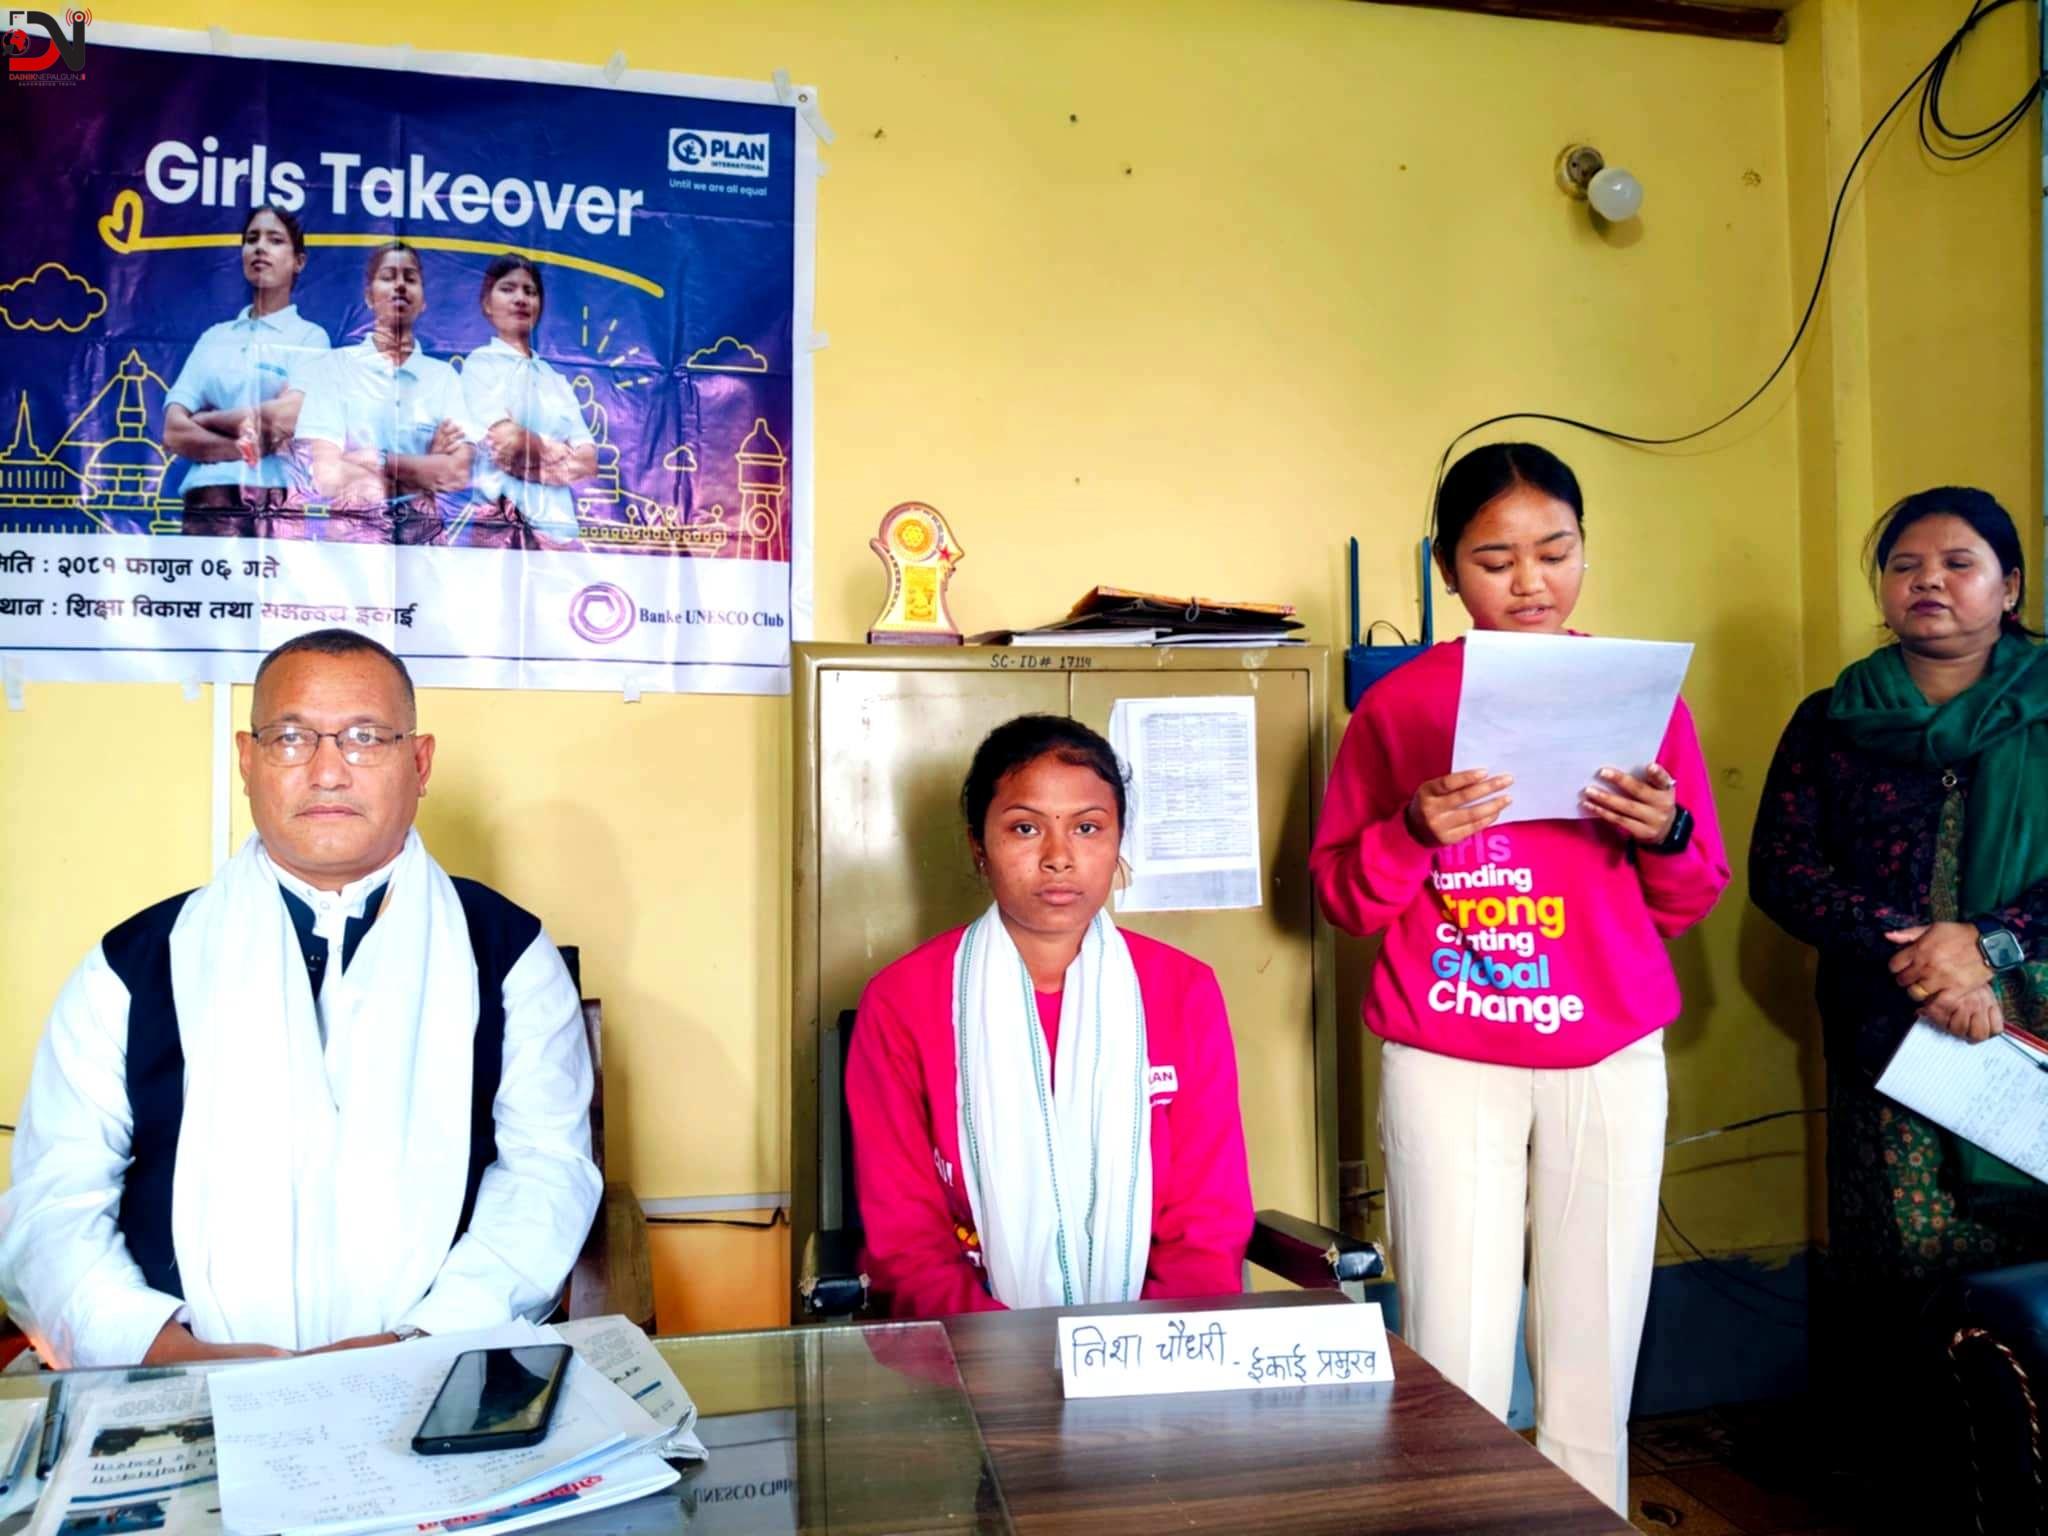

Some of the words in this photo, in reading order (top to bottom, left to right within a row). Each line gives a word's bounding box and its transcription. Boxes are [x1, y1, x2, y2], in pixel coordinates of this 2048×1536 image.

[711, 139, 765, 161] PLAN
[711, 161, 764, 171] INTERNATIONAL
[145, 135, 305, 211] Girls
[320, 151, 645, 237] Takeover
[669, 178, 692, 189] Until
[693, 182, 707, 191] we
[708, 183, 725, 192] are
[726, 184, 739, 194] all
[740, 186, 767, 198] equal
[58, 556, 115, 578] २०८१
[125, 557, 193, 583] फागुन
[201, 558, 231, 581] ०६
[243, 555, 281, 579] गते
[66, 593, 125, 620] शिक्षा
[132, 595, 201, 619] विकास
[210, 601, 254, 620] तथा
[639, 608, 682, 624] Banke
[686, 610, 748, 626] UNESCO
[753, 612, 784, 628] Club
[1431, 863, 1532, 893] tanding
[1441, 894, 1565, 939] trong
[1431, 948, 1550, 989] Global
[1428, 980, 1584, 1034] Change
[1072, 1325, 1142, 1377] निशा
[1156, 1320, 1227, 1366] चौधरी
[1316, 1349, 1377, 1378] प्रमुख
